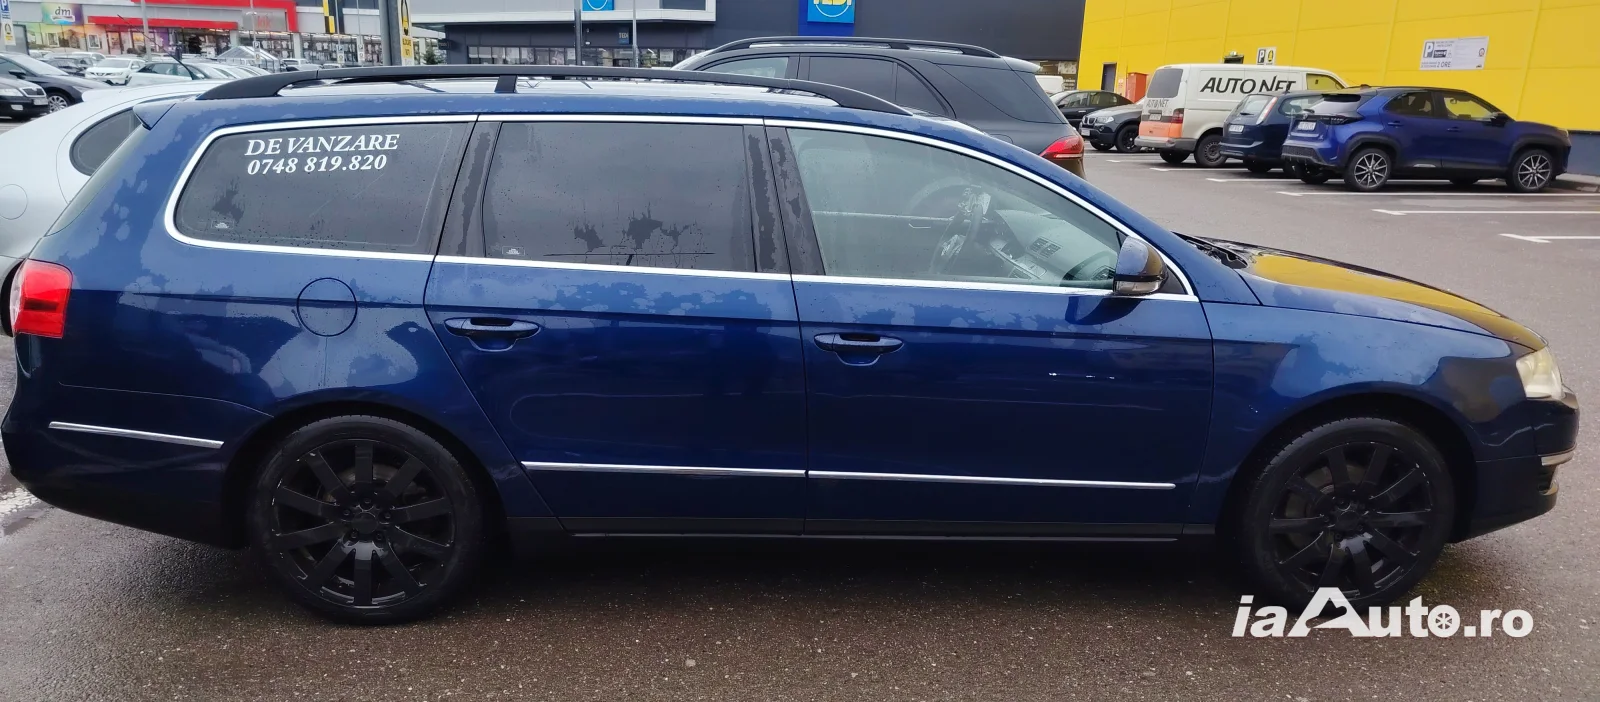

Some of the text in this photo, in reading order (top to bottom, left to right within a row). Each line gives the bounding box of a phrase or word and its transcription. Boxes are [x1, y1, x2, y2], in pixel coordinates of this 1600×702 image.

[54, 6, 71, 16] dm
[1424, 42, 1434, 58] P
[1200, 75, 1296, 94] AUTO NET
[244, 133, 400, 156] DE VANZARE
[247, 154, 388, 175] 0748 819.820
